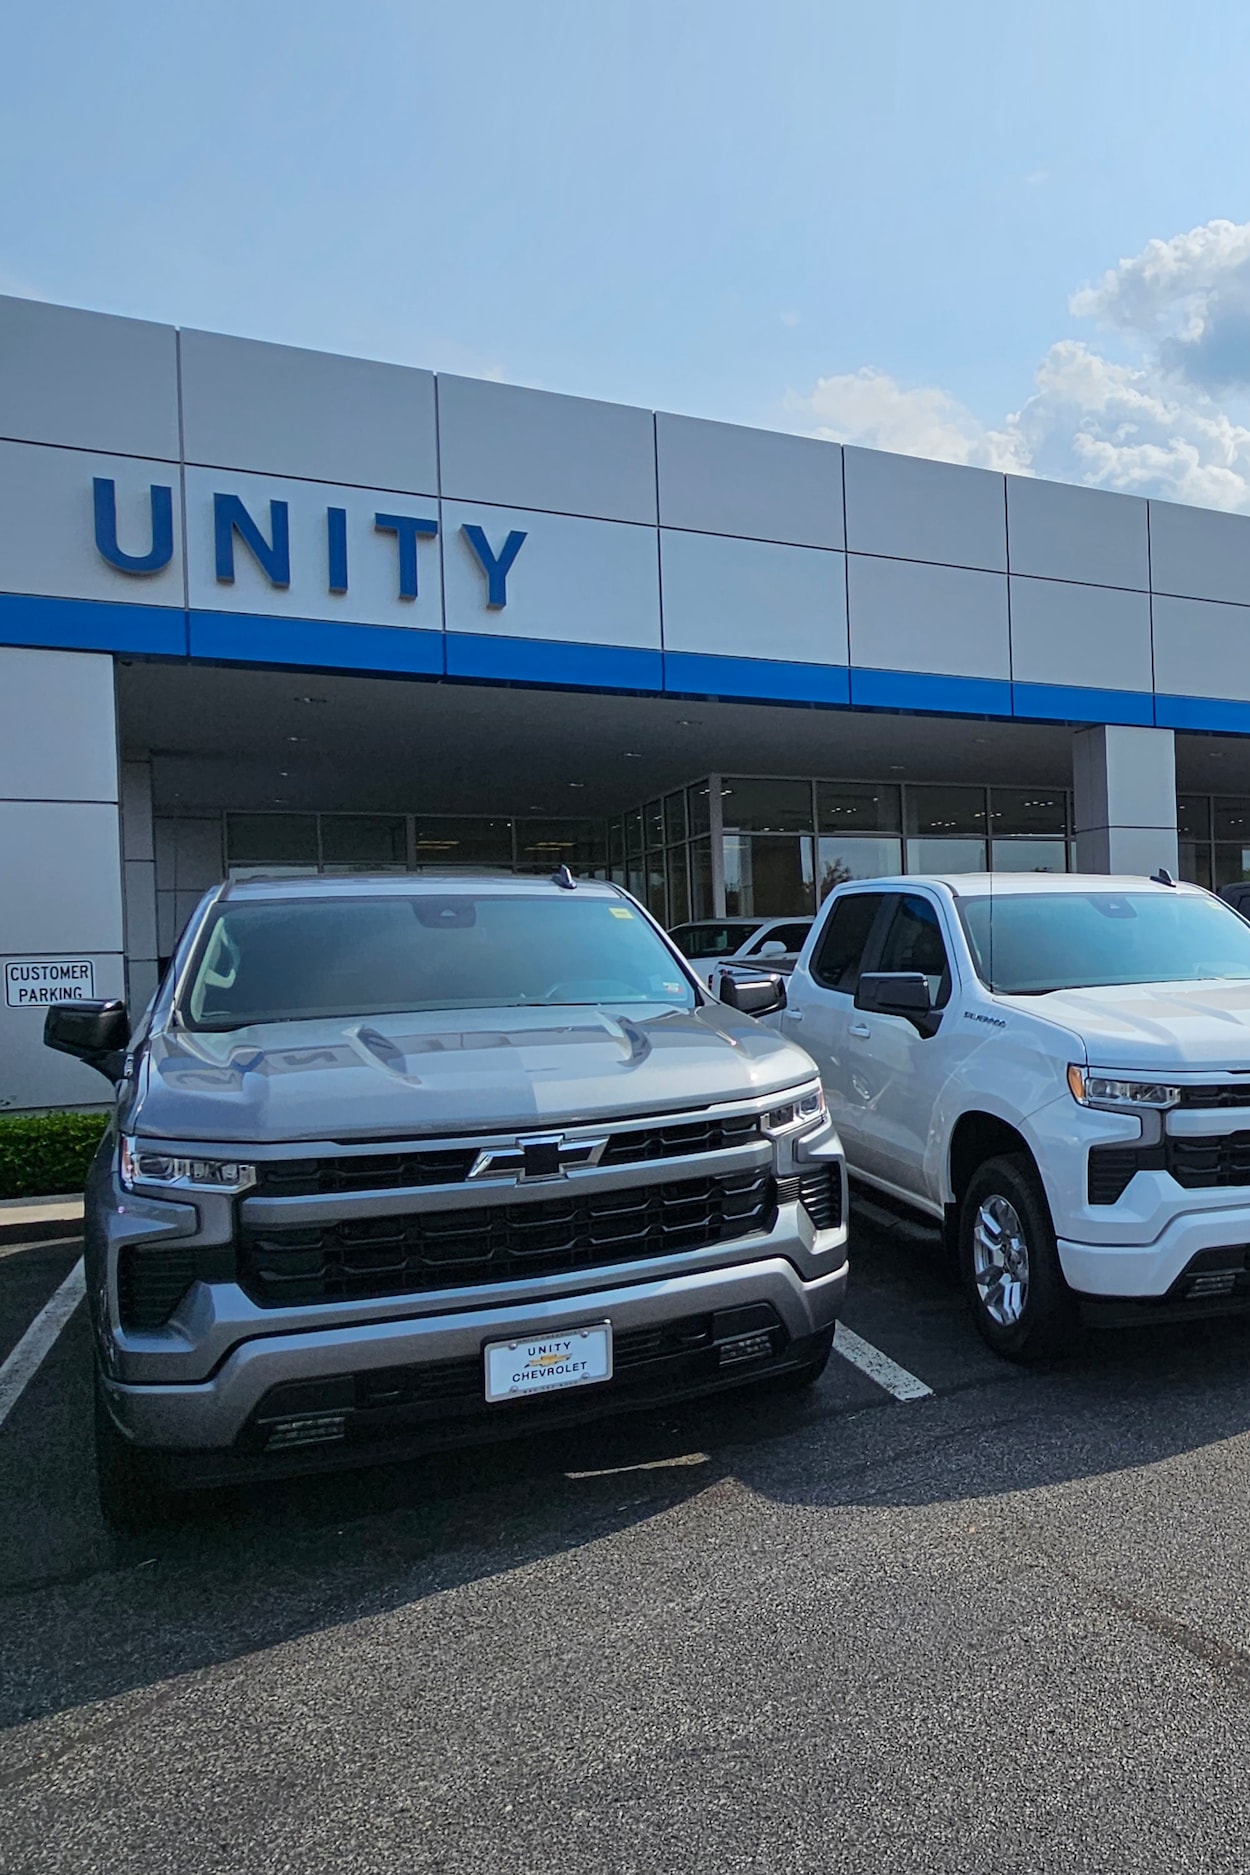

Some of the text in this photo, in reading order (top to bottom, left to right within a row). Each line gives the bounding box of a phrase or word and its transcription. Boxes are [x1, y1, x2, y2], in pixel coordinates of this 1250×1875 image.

[93, 477, 528, 610] UNITY
[10, 965, 89, 981] CUSTOMER
[19, 986, 82, 1003] PARKING
[528, 1341, 572, 1356] UNITY
[512, 1361, 588, 1382] CHEVROLET
